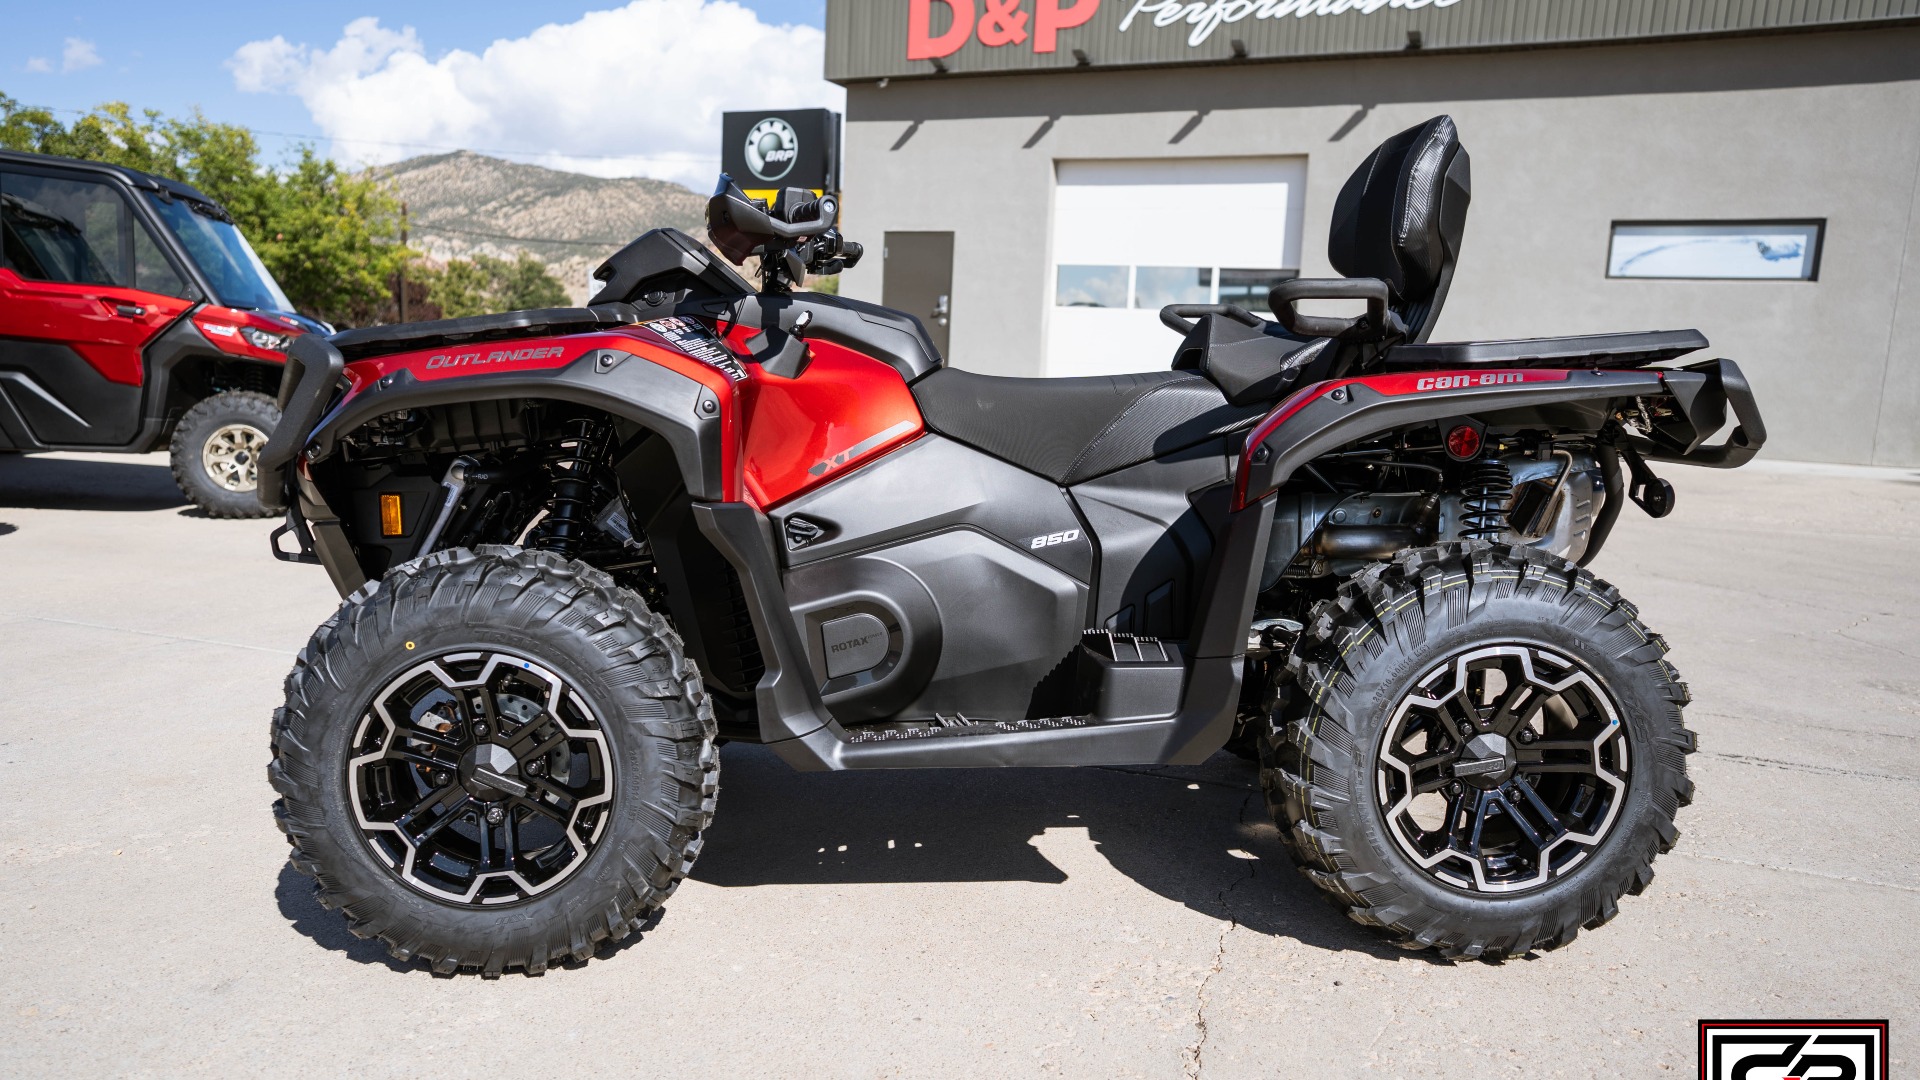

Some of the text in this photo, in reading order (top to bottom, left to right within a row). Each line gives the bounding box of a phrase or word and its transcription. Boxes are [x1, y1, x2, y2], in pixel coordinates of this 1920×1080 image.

[907, 0, 1100, 60] D&P
[765, 150, 794, 162] BRP
[426, 346, 565, 370] OUTLANDER
[1416, 372, 1524, 391] can-am
[823, 446, 854, 473] XT
[1030, 529, 1080, 549] 850
[830, 636, 869, 653] ROTAX
